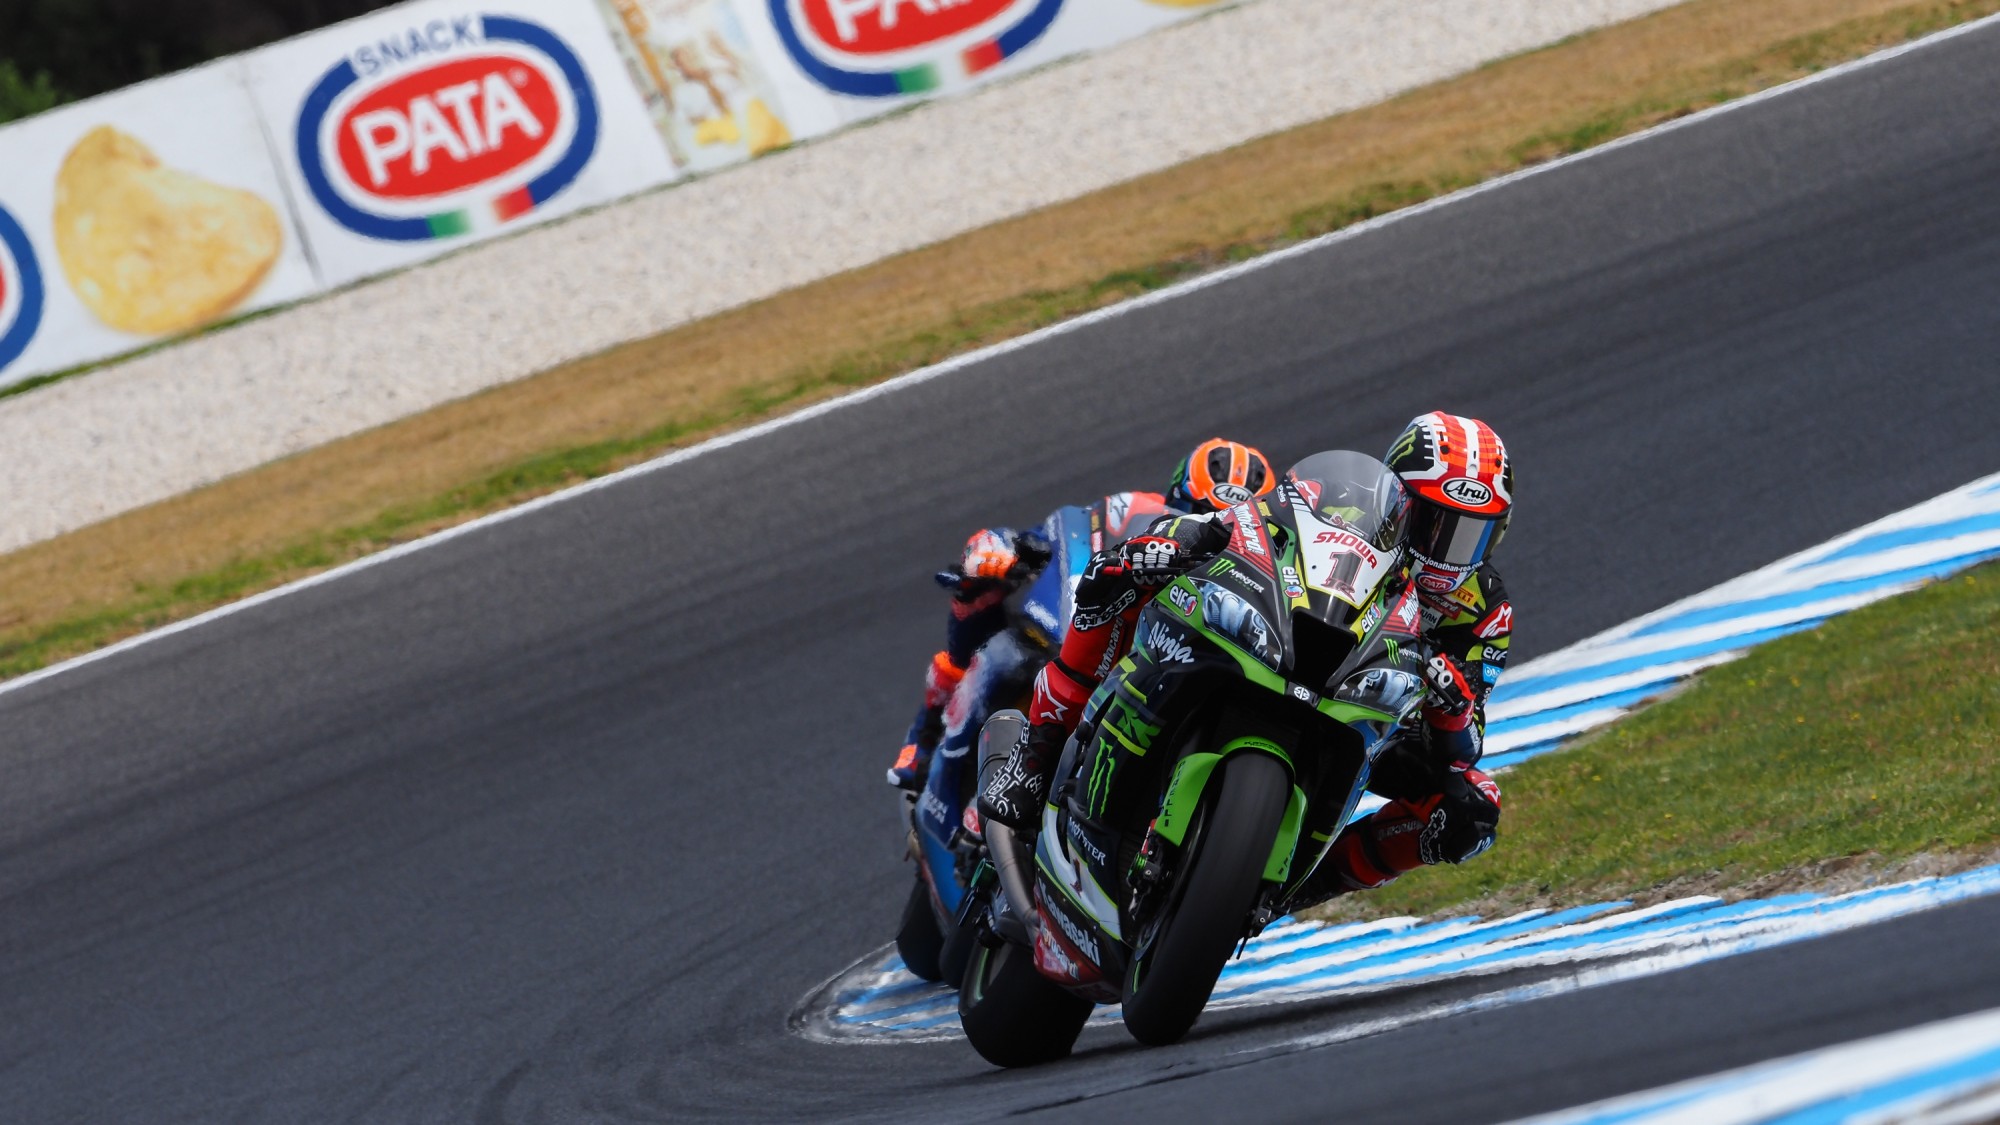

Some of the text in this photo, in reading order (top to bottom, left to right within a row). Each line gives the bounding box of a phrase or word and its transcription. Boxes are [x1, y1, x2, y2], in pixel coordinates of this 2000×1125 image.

[355, 15, 481, 77] SNACK
[350, 72, 543, 188] PATA
[1446, 481, 1487, 500] Arai
[1313, 531, 1378, 569] SHOWA
[1408, 547, 1484, 572] www.jonathan-rea.com
[1282, 566, 1300, 585] elf
[1422, 577, 1447, 590] PATA
[1169, 585, 1187, 609] elf
[1361, 611, 1374, 633] elf
[1148, 621, 1195, 664] Ninja
[1038, 877, 1101, 967] Kawasaki
